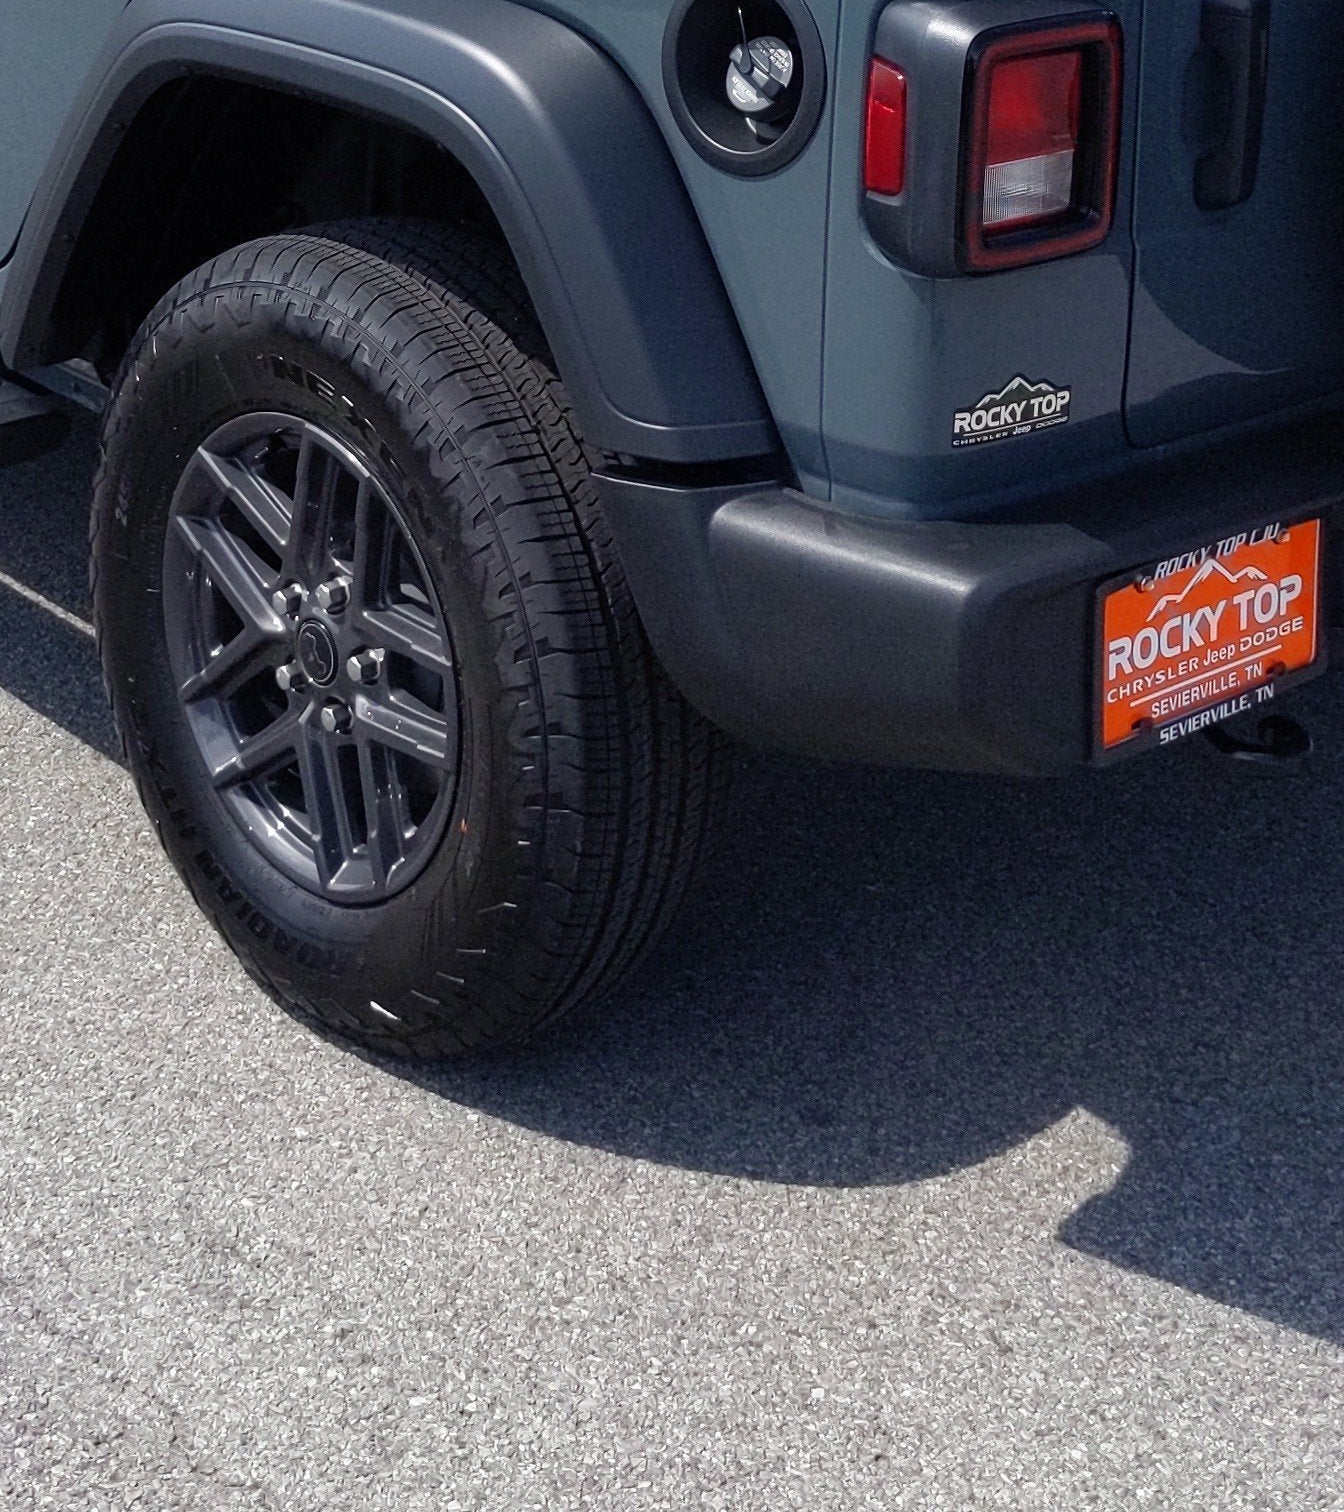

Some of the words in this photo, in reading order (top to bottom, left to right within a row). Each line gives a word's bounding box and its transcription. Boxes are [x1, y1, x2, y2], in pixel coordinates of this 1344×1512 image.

[952, 431, 1009, 447] CHRYSLER
[1012, 424, 1032, 436] Jeep
[953, 399, 1028, 434] ROCKY
[1029, 390, 1070, 418] TOP
[1155, 544, 1213, 582] ROCKY
[1214, 531, 1248, 562] TOP
[1107, 599, 1228, 681] ROCKY
[1232, 573, 1303, 632] TOP
[1106, 656, 1201, 705] CHRYSLER
[1203, 642, 1237, 668] Jeep
[1239, 616, 1304, 653] DODGE
[1150, 670, 1241, 719] SEVIERVILLE,
[1244, 661, 1264, 678] TN
[1159, 692, 1252, 745] SEVIERVILLE,
[1255, 682, 1275, 703] TN
